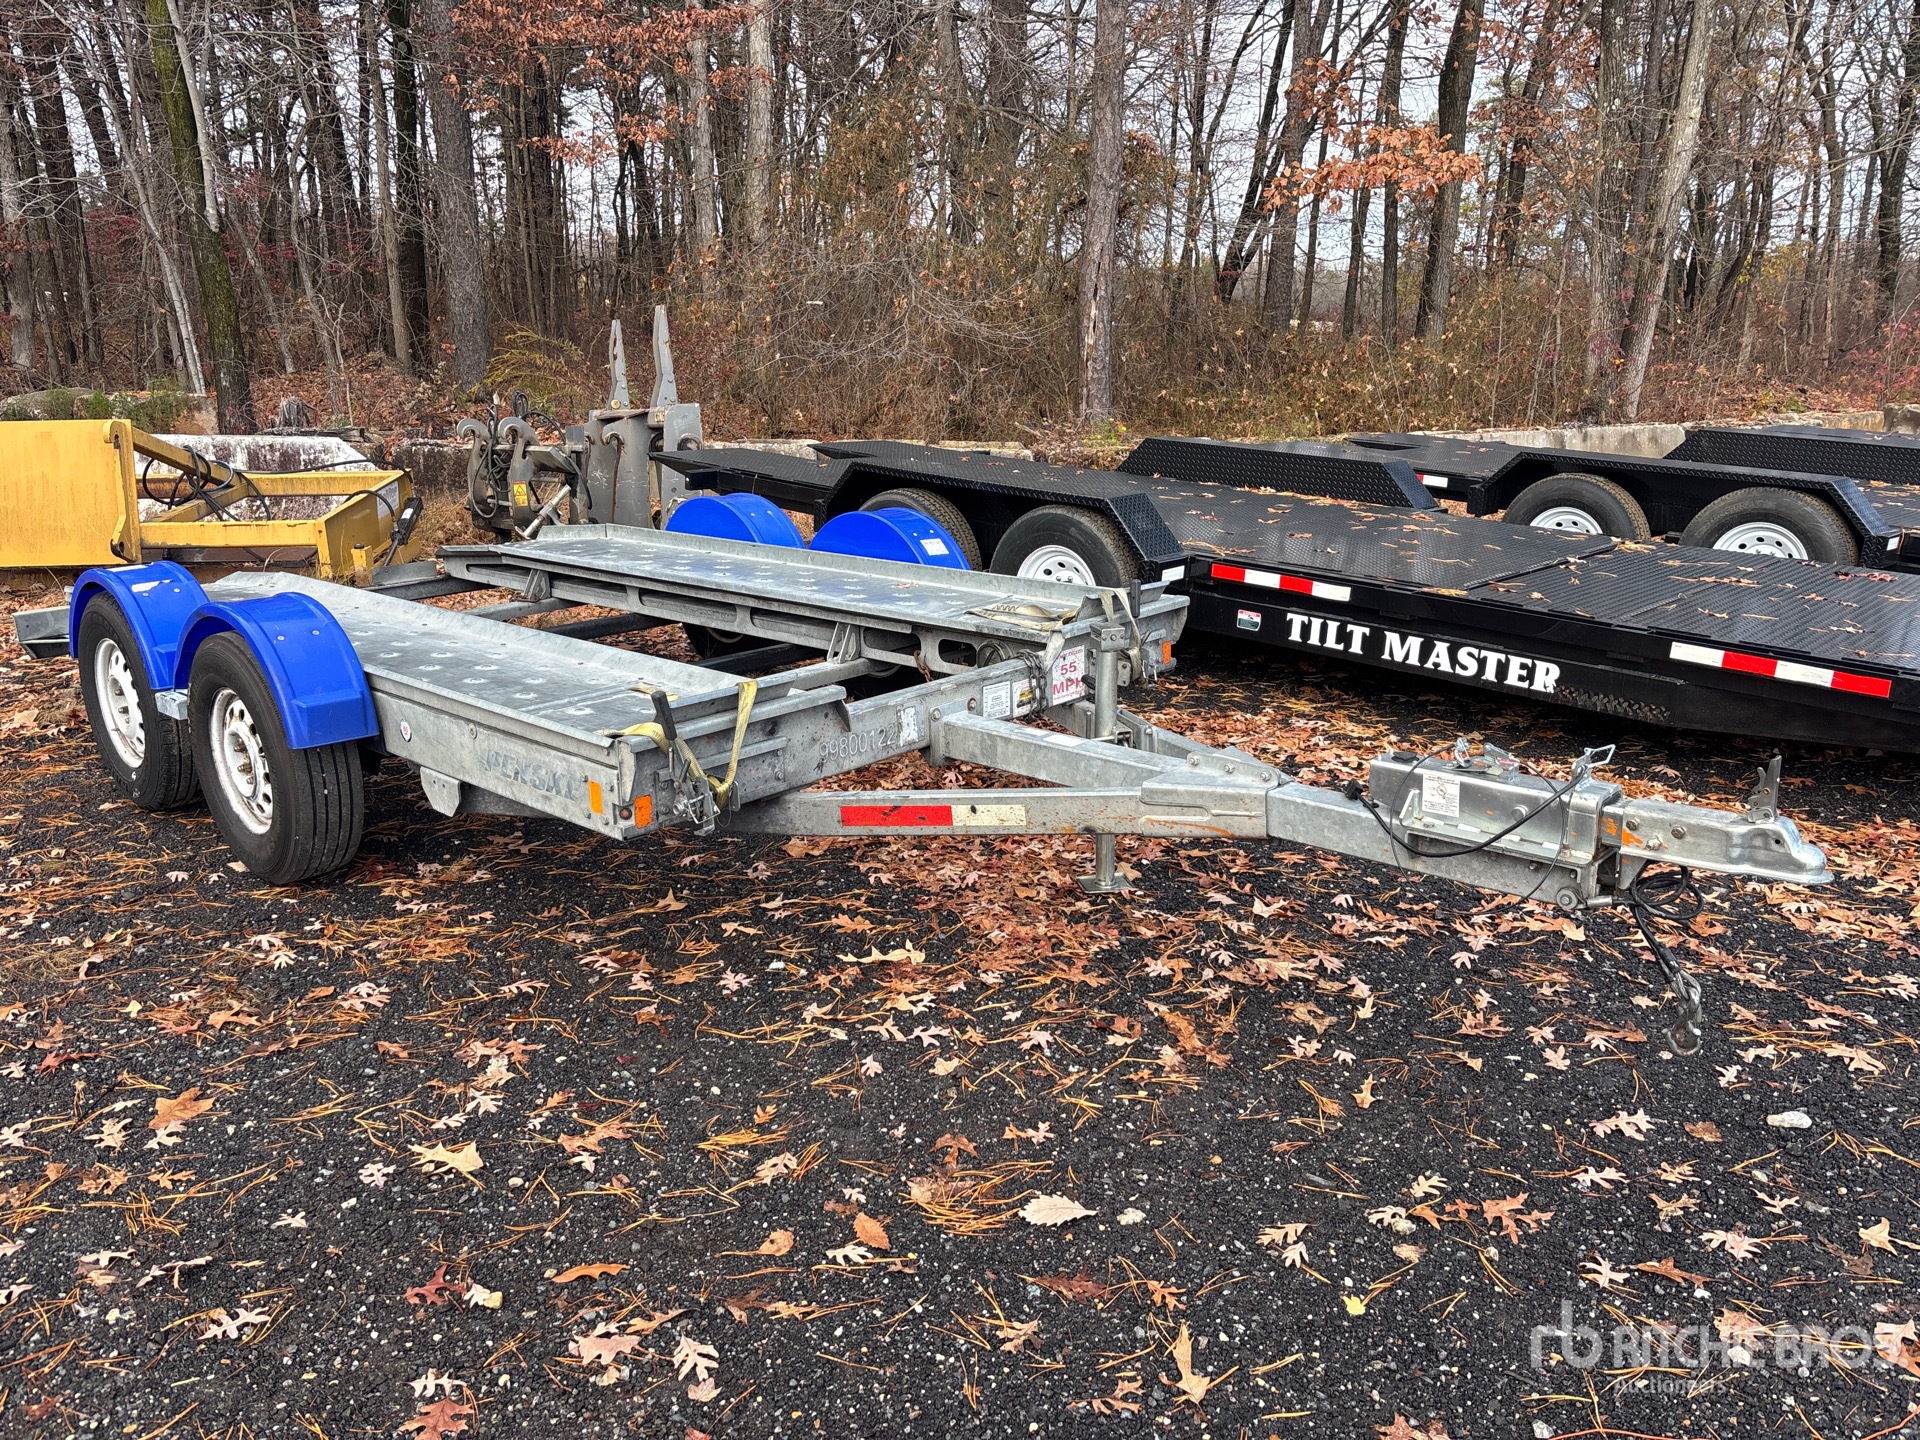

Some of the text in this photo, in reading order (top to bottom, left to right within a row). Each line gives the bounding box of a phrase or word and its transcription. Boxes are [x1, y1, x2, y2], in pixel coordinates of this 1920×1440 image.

[1060, 661, 1077, 675] 55
[1286, 612, 1370, 655] TILT
[1381, 630, 1561, 694] MASTER
[820, 724, 896, 762] 99800122
[484, 750, 580, 802] PENSKE
